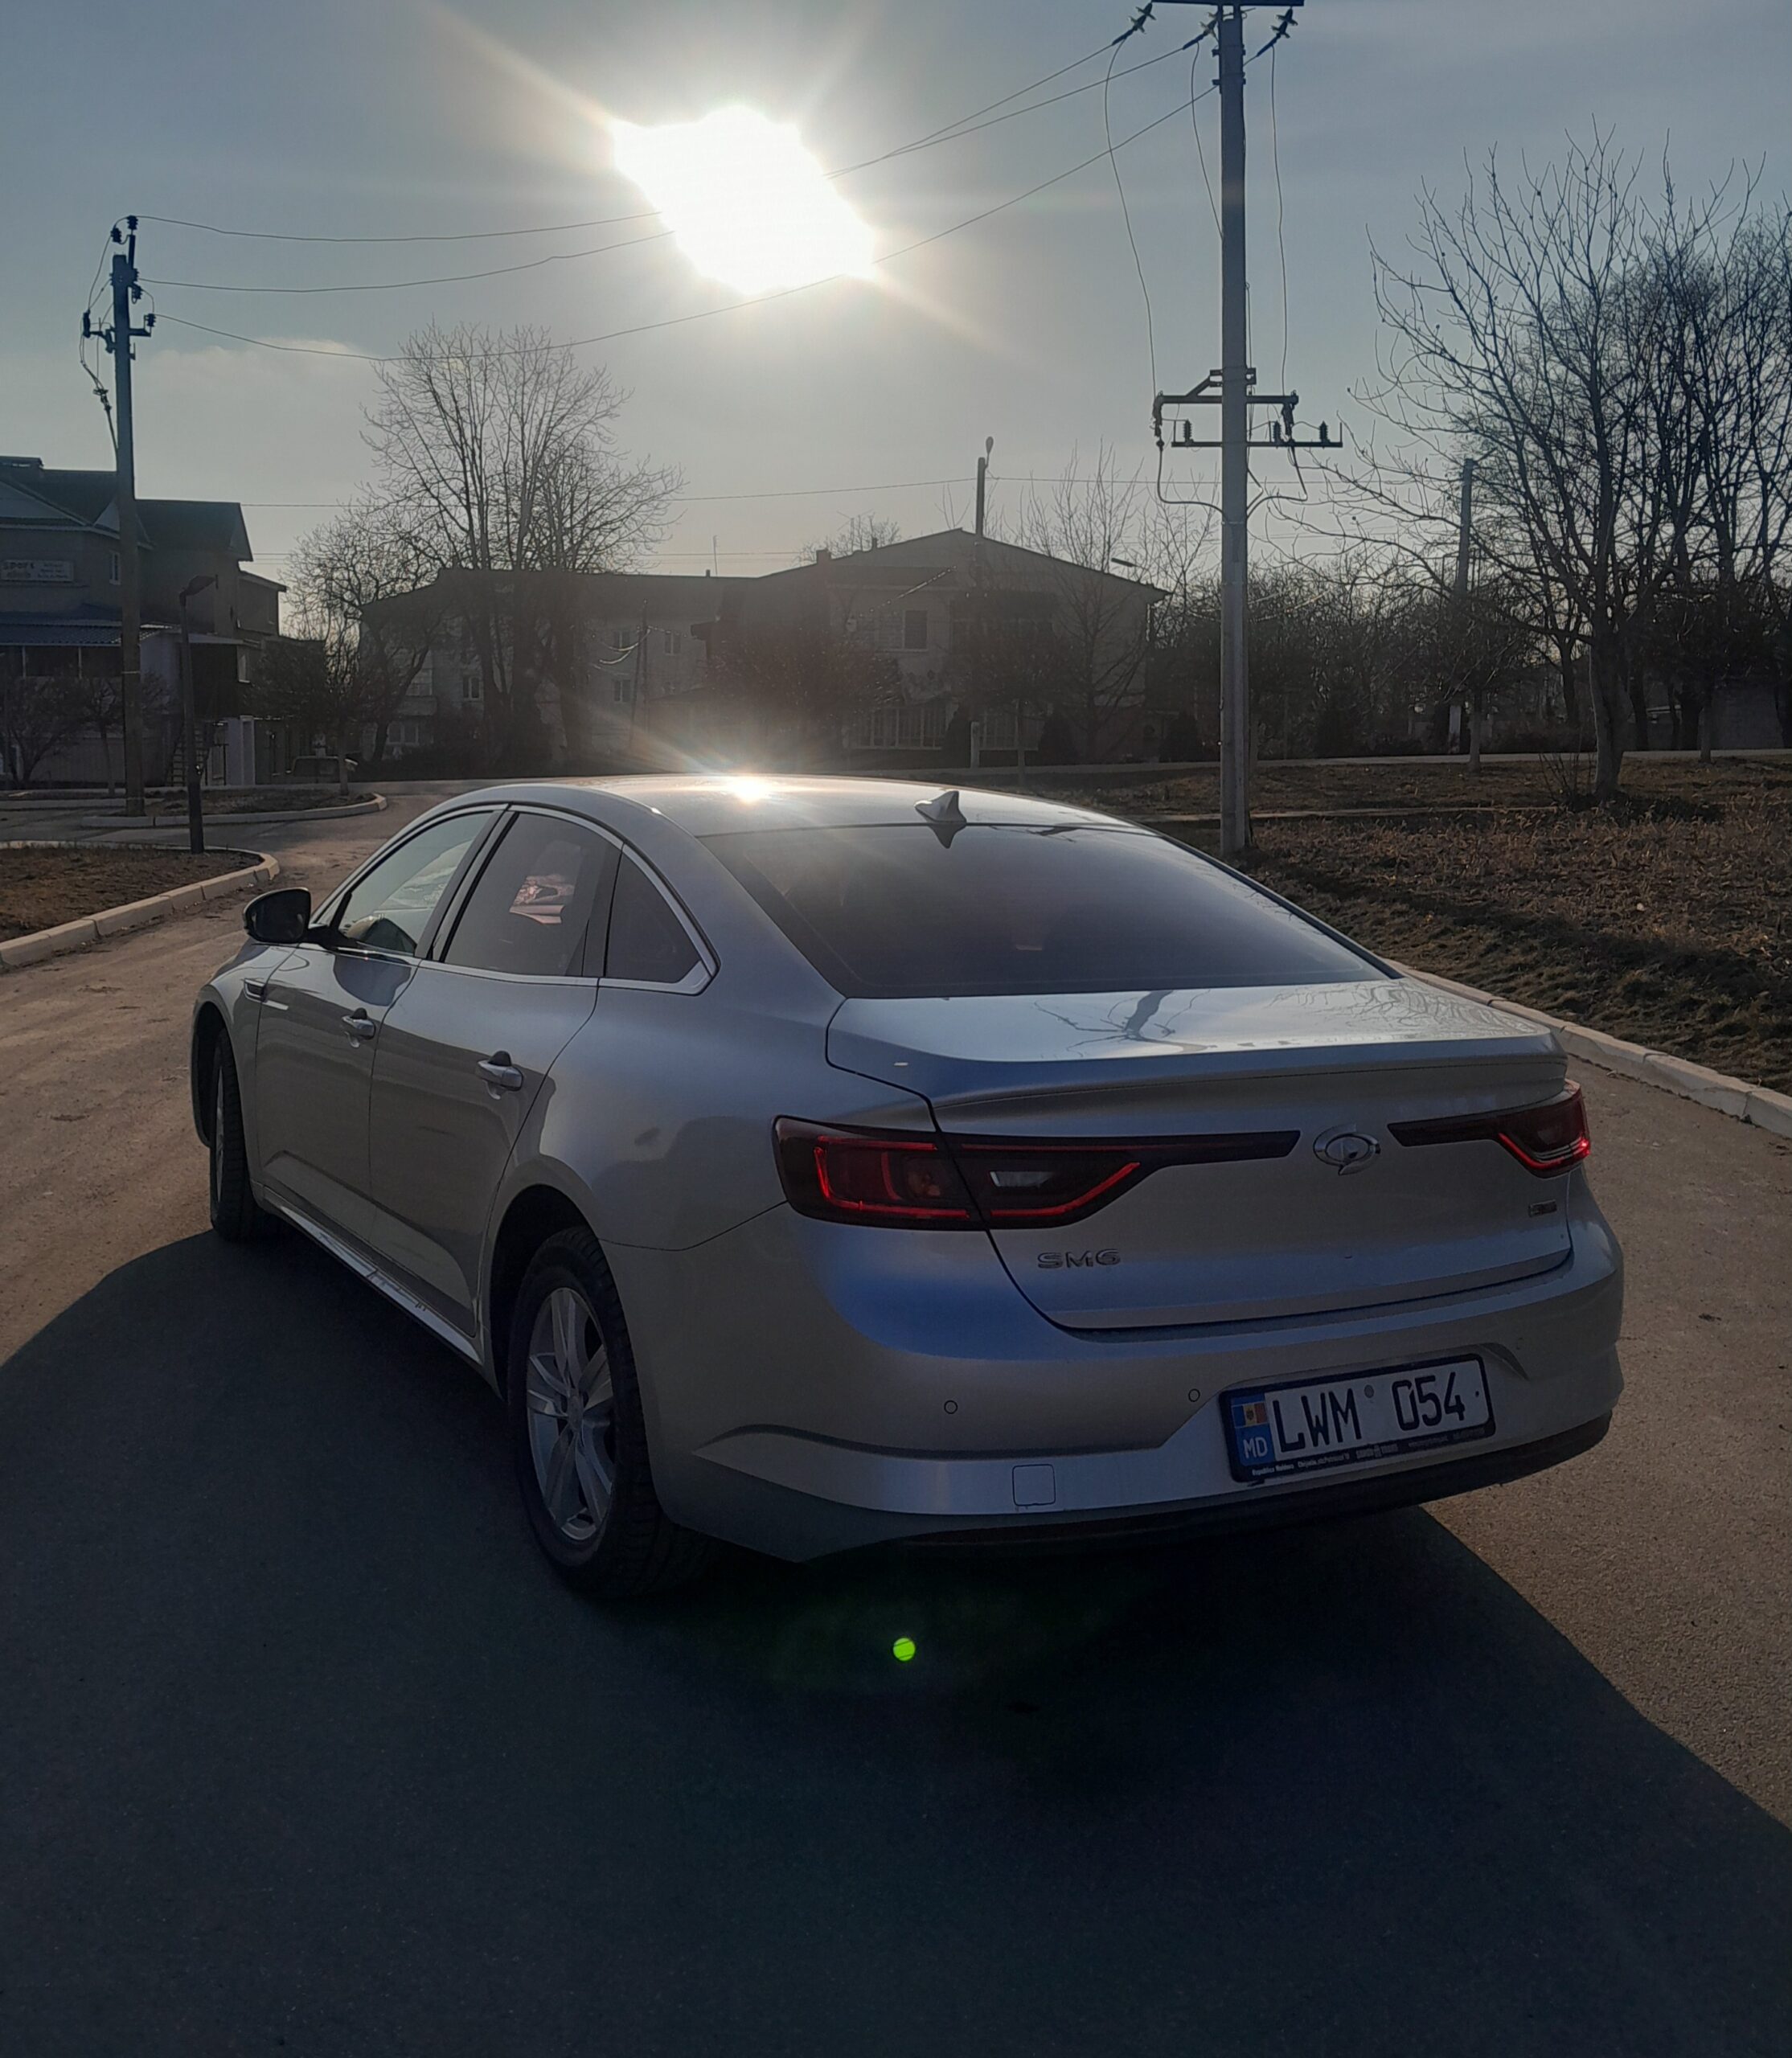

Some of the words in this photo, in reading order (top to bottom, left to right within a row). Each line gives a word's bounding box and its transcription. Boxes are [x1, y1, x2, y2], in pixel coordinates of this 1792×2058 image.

[1037, 1248, 1122, 1269] SM6
[1272, 1388, 1363, 1453] LWM
[1391, 1371, 1466, 1432] 054
[1243, 1436, 1269, 1460] MD
